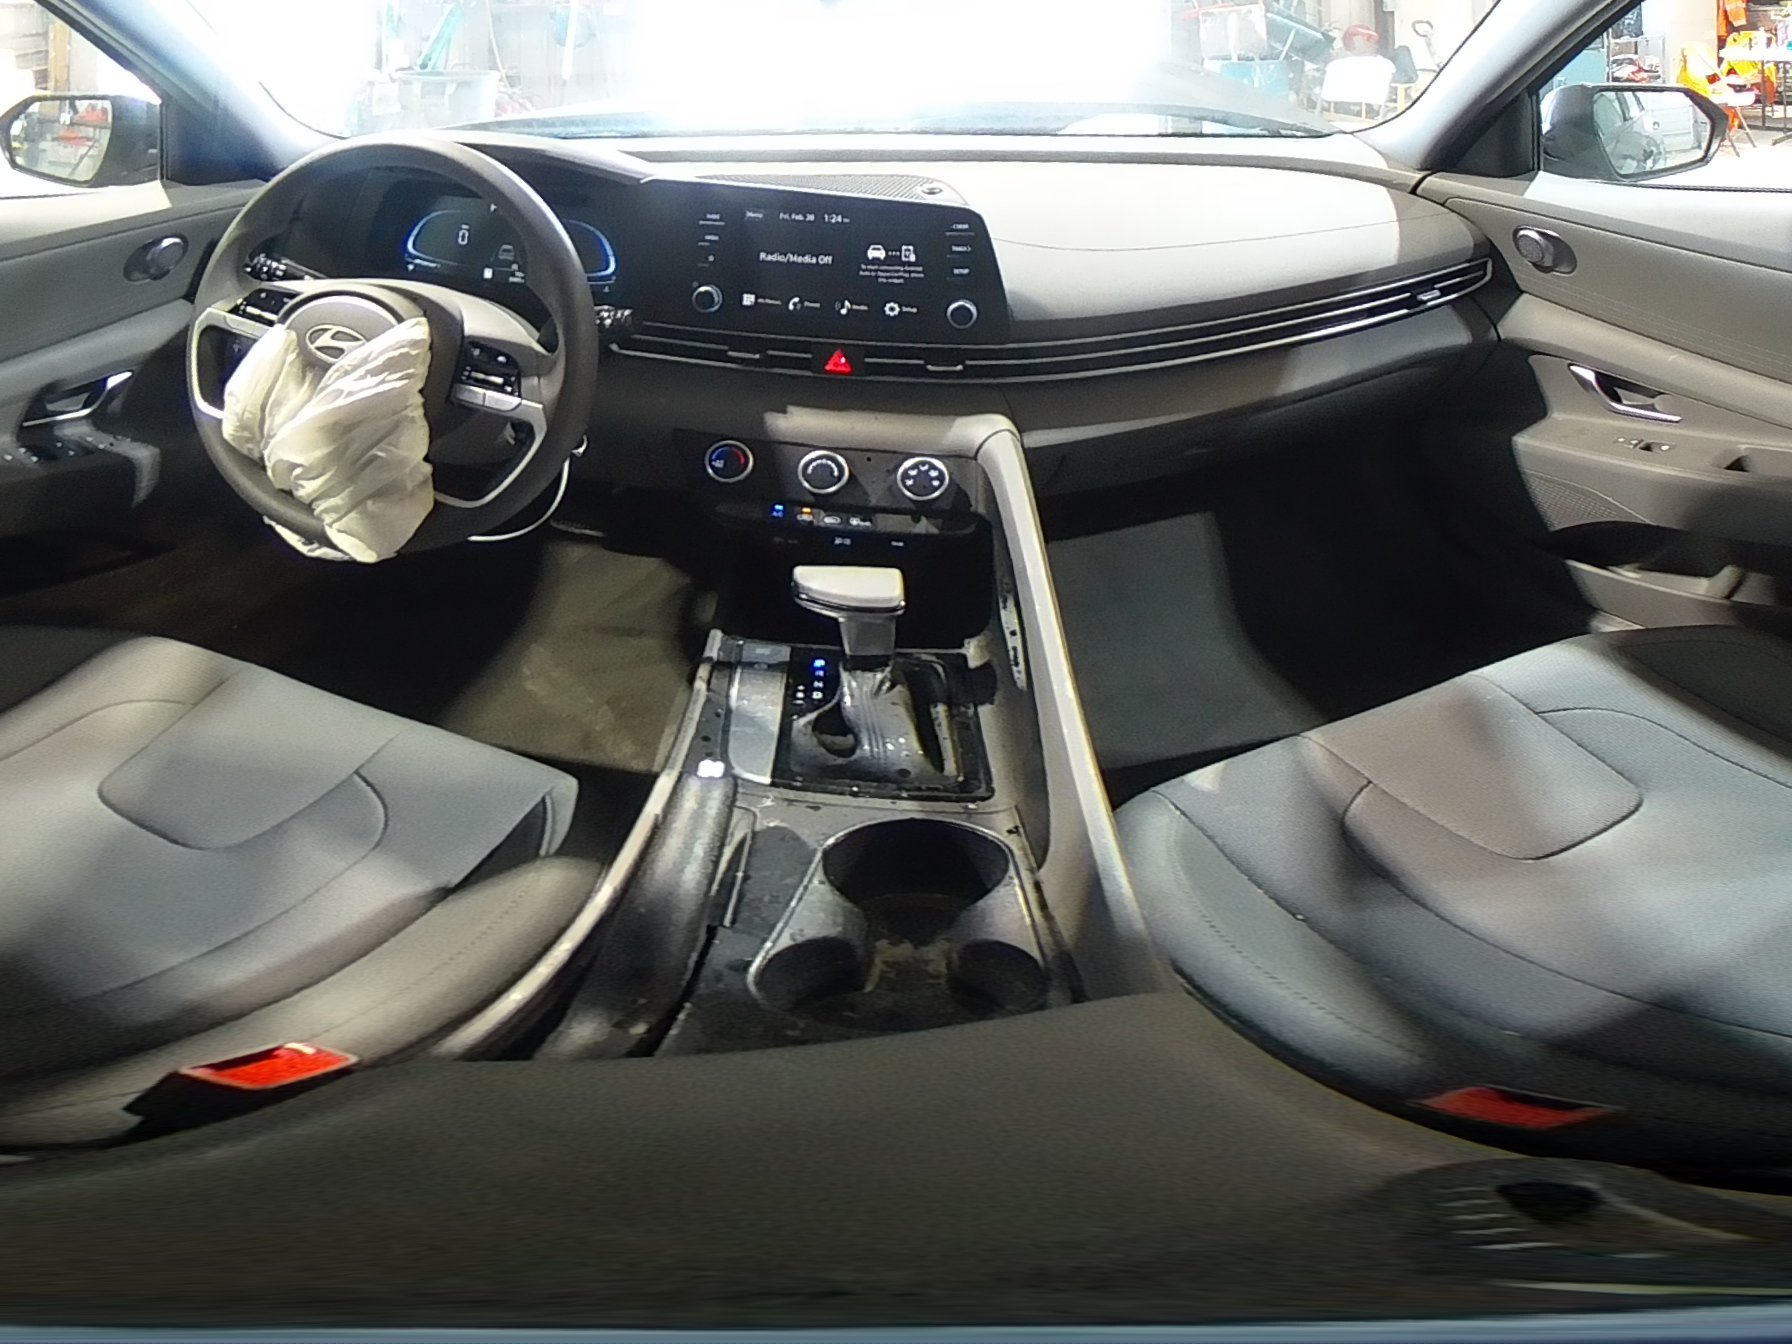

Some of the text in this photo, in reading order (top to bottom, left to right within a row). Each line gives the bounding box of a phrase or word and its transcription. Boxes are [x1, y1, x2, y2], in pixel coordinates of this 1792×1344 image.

[824, 214, 843, 223] 1:24
[759, 251, 834, 265] Radio/Media Off
